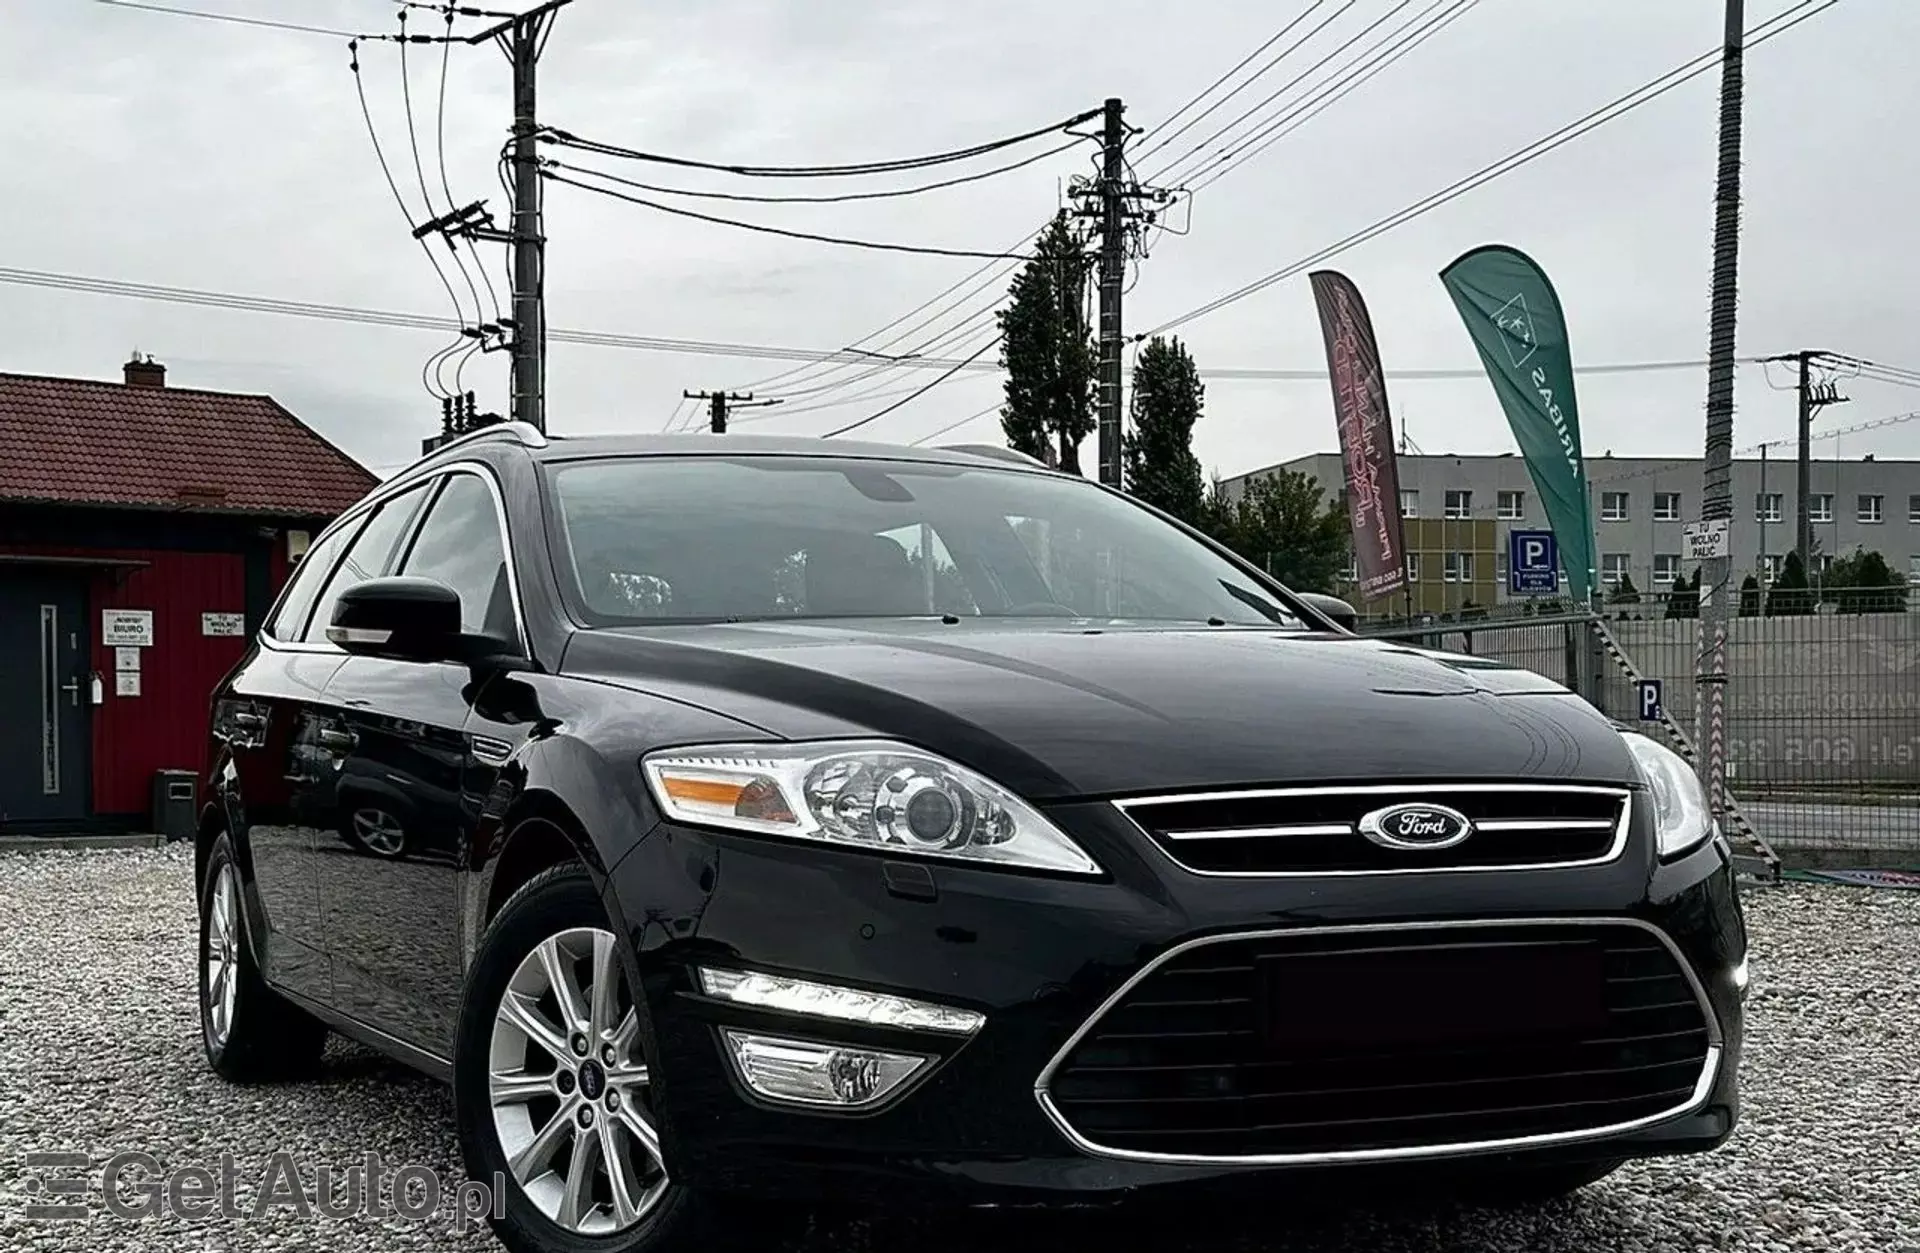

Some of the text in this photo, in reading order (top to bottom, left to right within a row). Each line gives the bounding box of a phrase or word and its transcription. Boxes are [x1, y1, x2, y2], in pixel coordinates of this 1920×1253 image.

[1526, 541, 1544, 566] P
[1643, 685, 1657, 717] P
[1398, 812, 1447, 835] Ford
